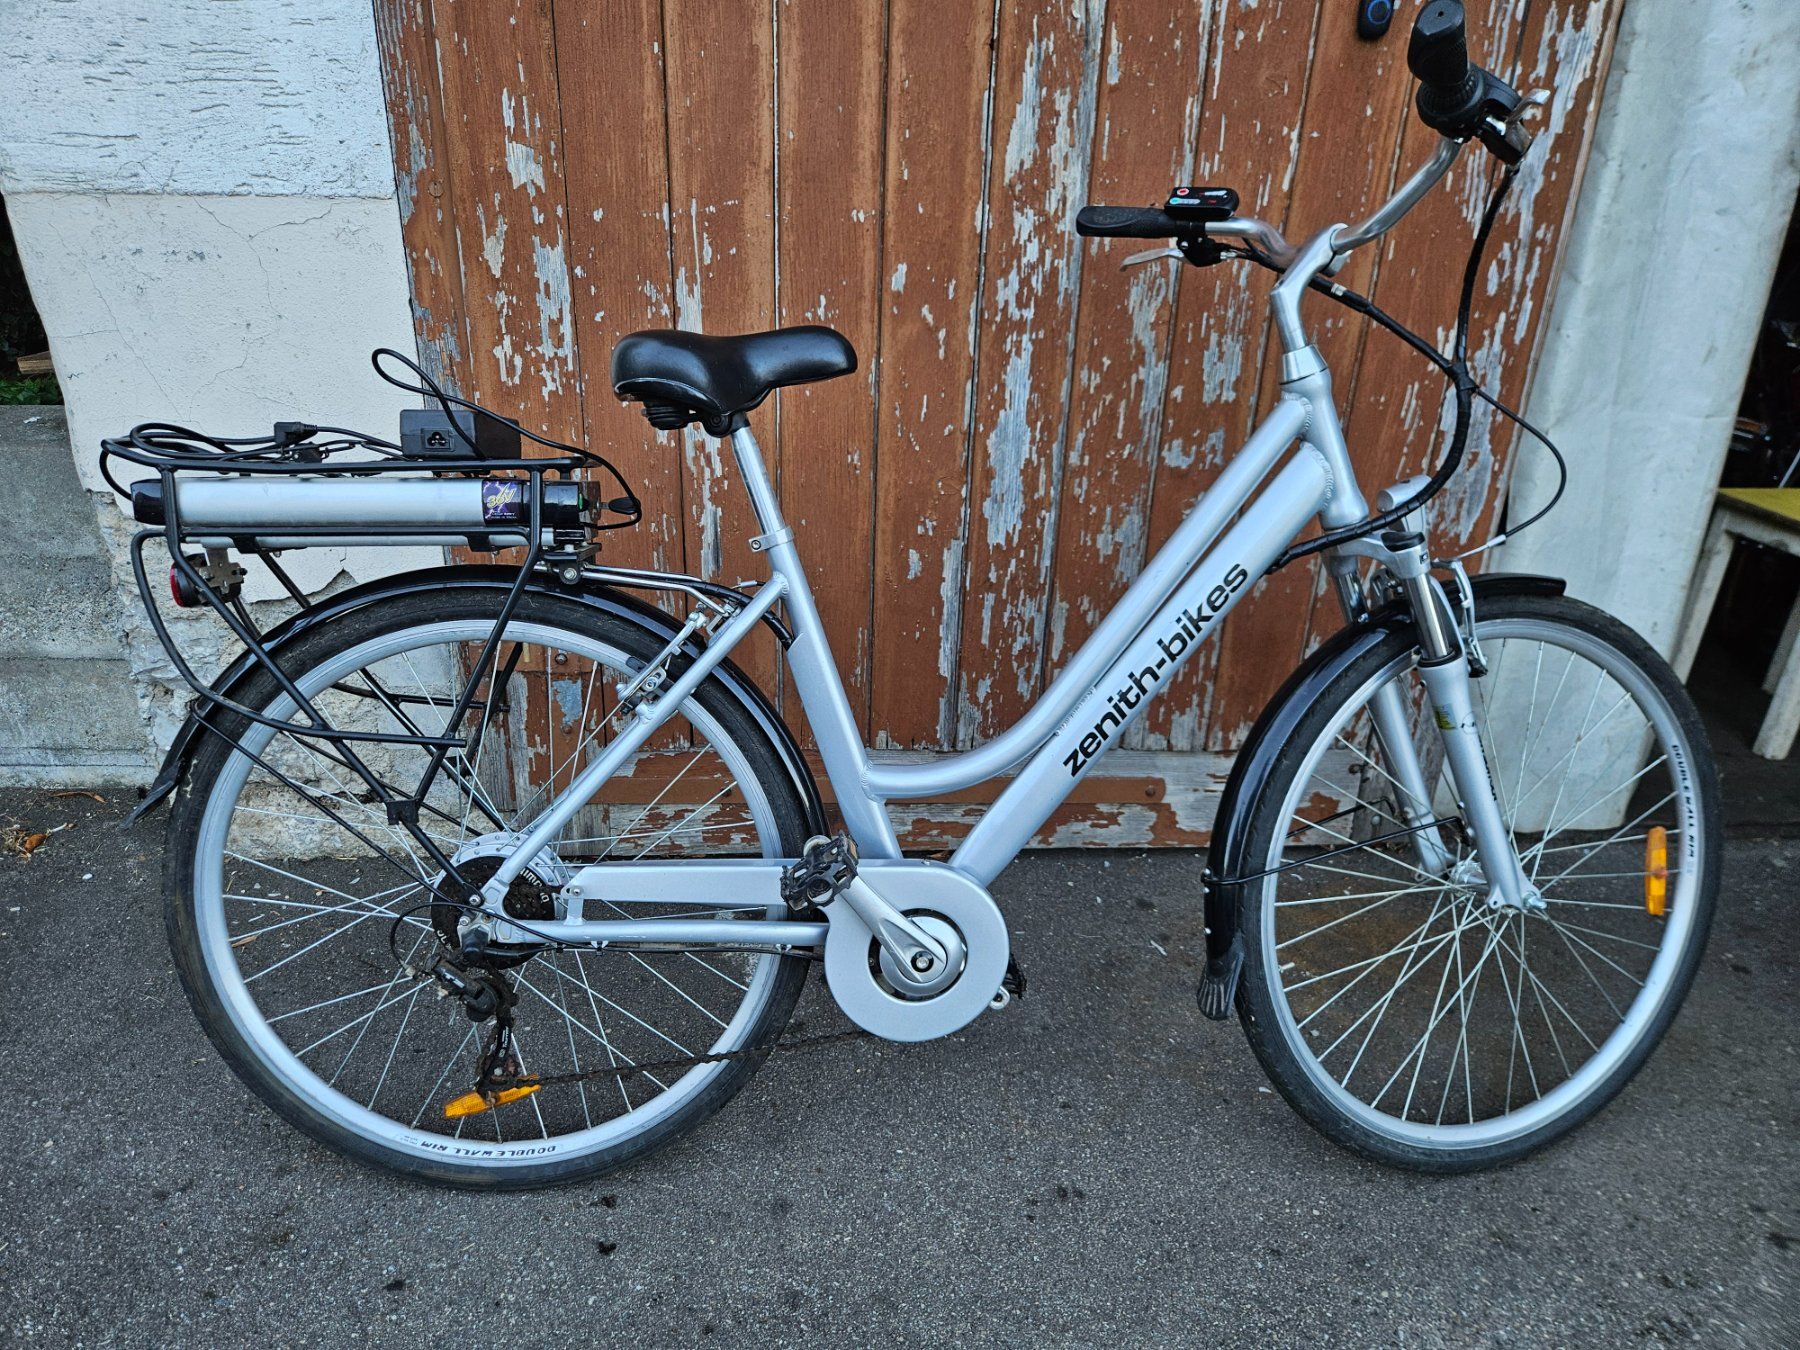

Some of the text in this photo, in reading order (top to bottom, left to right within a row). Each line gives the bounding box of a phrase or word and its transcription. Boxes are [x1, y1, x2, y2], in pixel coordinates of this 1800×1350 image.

[486, 482, 517, 509] 36V
[1062, 563, 1249, 778] zenith-bikes
[1672, 744, 1690, 790] DOUBLE
[420, 1140, 556, 1157] DOUBLE WALL RIM
